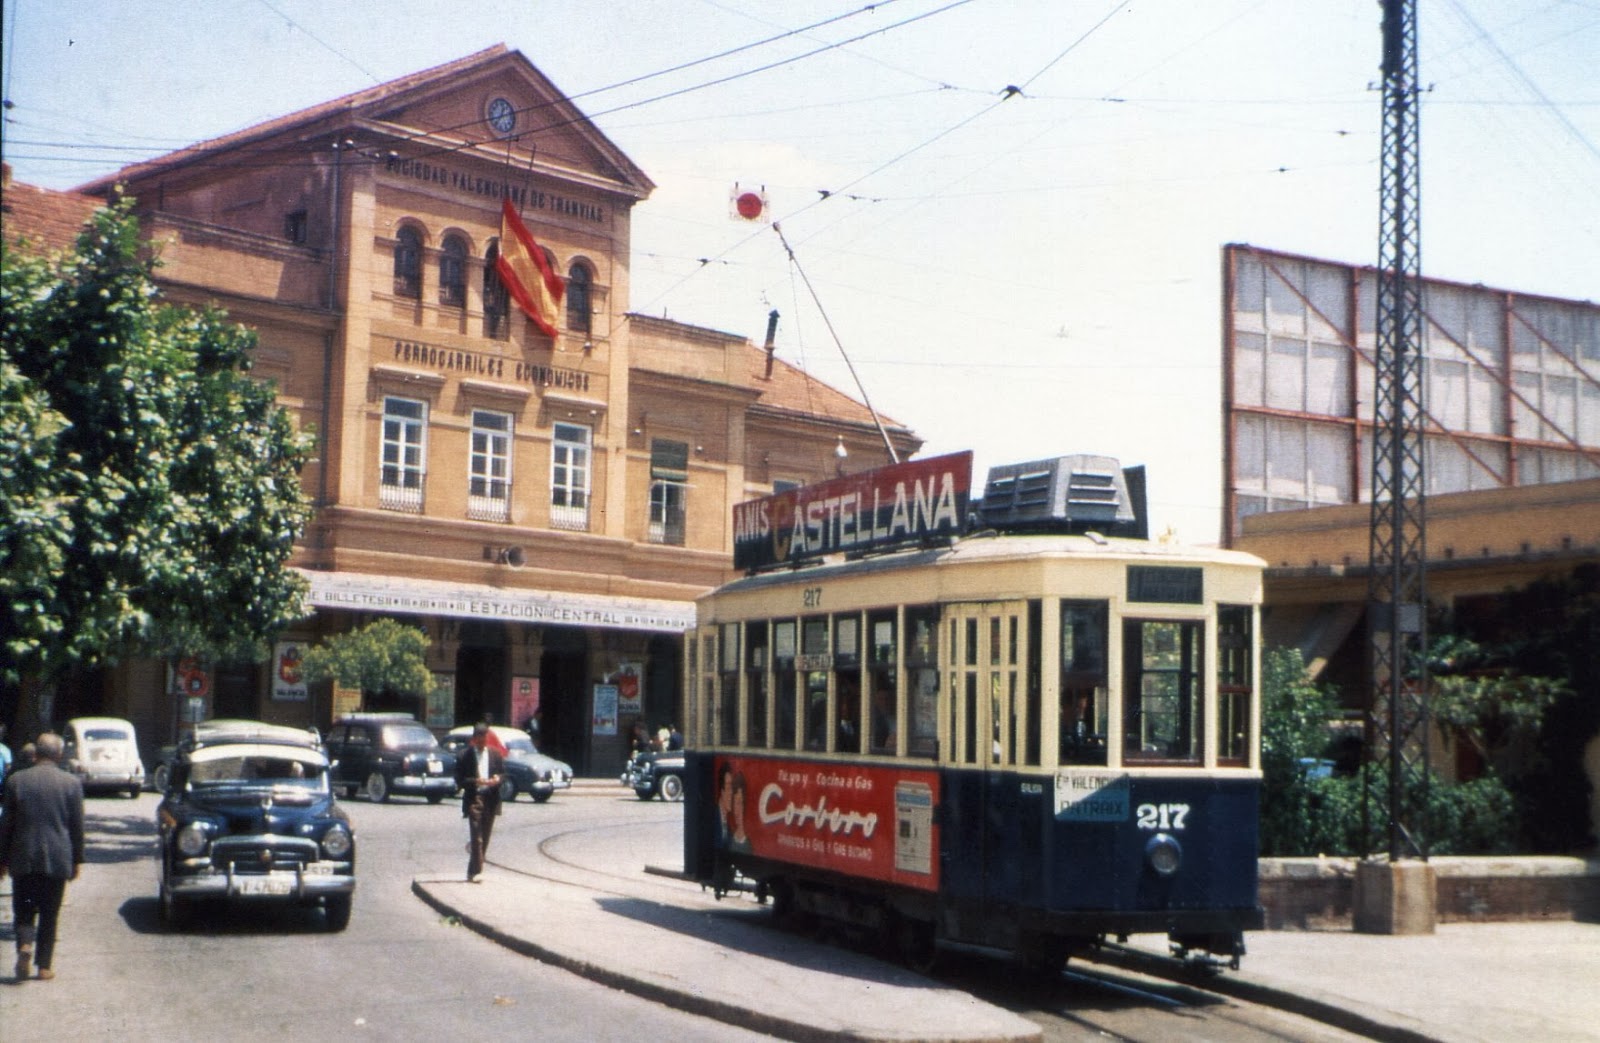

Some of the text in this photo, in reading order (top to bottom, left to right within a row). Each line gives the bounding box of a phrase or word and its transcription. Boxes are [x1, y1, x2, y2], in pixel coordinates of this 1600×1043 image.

[385, 159, 448, 185] SOCIEDAD
[530, 189, 546, 209] DE
[549, 194, 604, 223] TRANVIAS
[394, 340, 591, 392] FERROCARRILES ECONOMICOS
[735, 471, 958, 562] ANIS CASTELLANA
[324, 591, 385, 606] BILLETES
[470, 602, 544, 619] ESTACION
[552, 607, 620, 624] CENTRAL
[802, 587, 823, 608] 217
[854, 775, 873, 790] Gas
[757, 782, 879, 840] Corbero
[1136, 803, 1191, 830] 217
